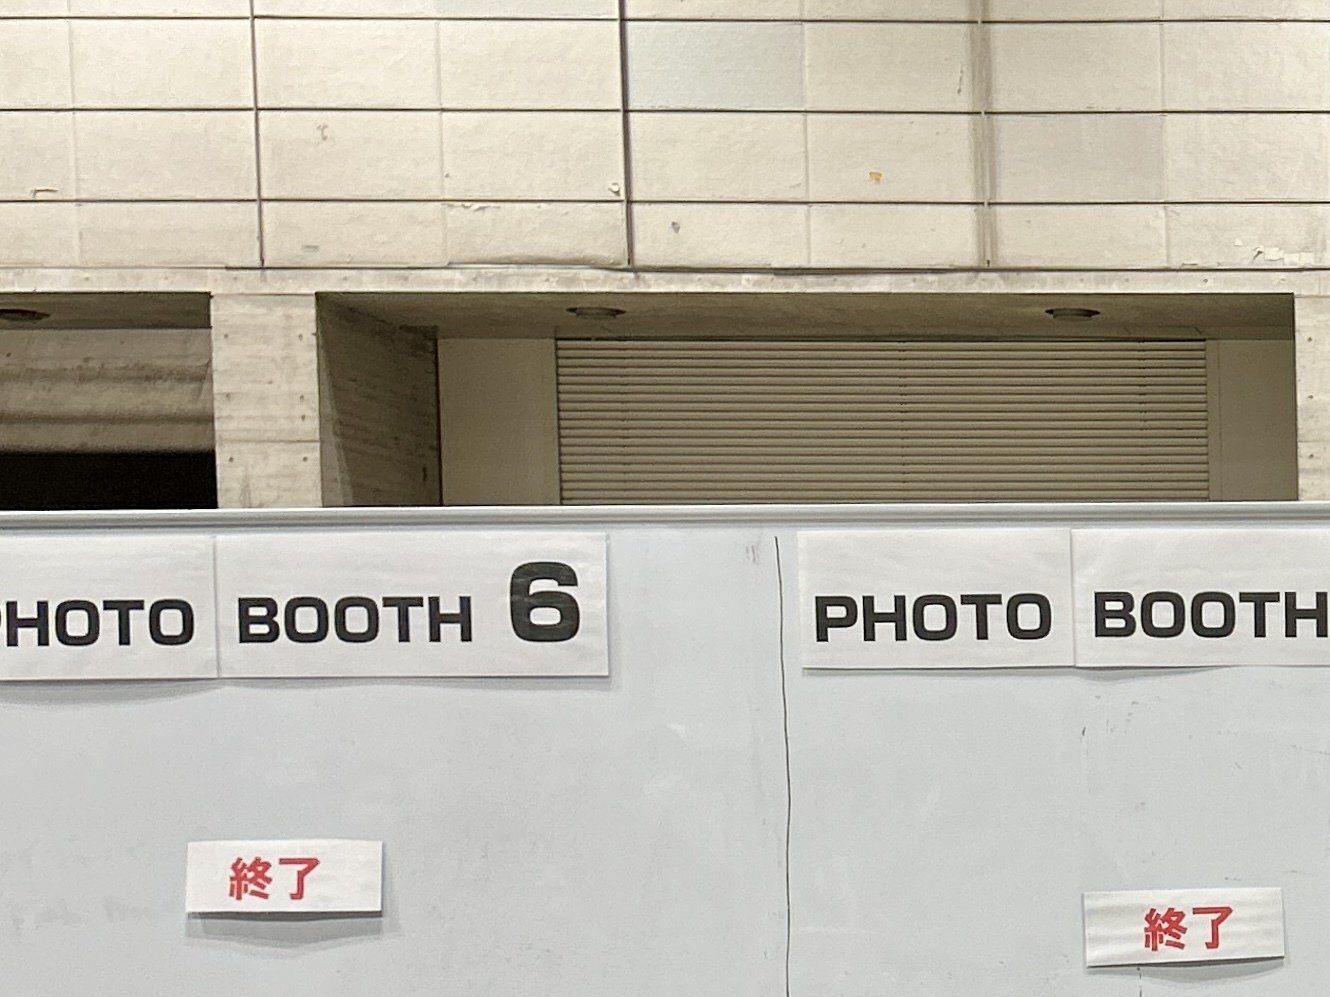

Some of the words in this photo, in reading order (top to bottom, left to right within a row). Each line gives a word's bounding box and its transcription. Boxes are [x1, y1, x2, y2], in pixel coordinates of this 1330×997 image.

[0, 599, 194, 646] HOTO
[238, 596, 472, 643] BOOTH
[510, 562, 580, 642] 6
[815, 594, 1051, 642] PHOTO
[1095, 592, 1328, 638] BOOTH
[231, 857, 319, 900] 終了
[1146, 906, 1232, 950] 終了
